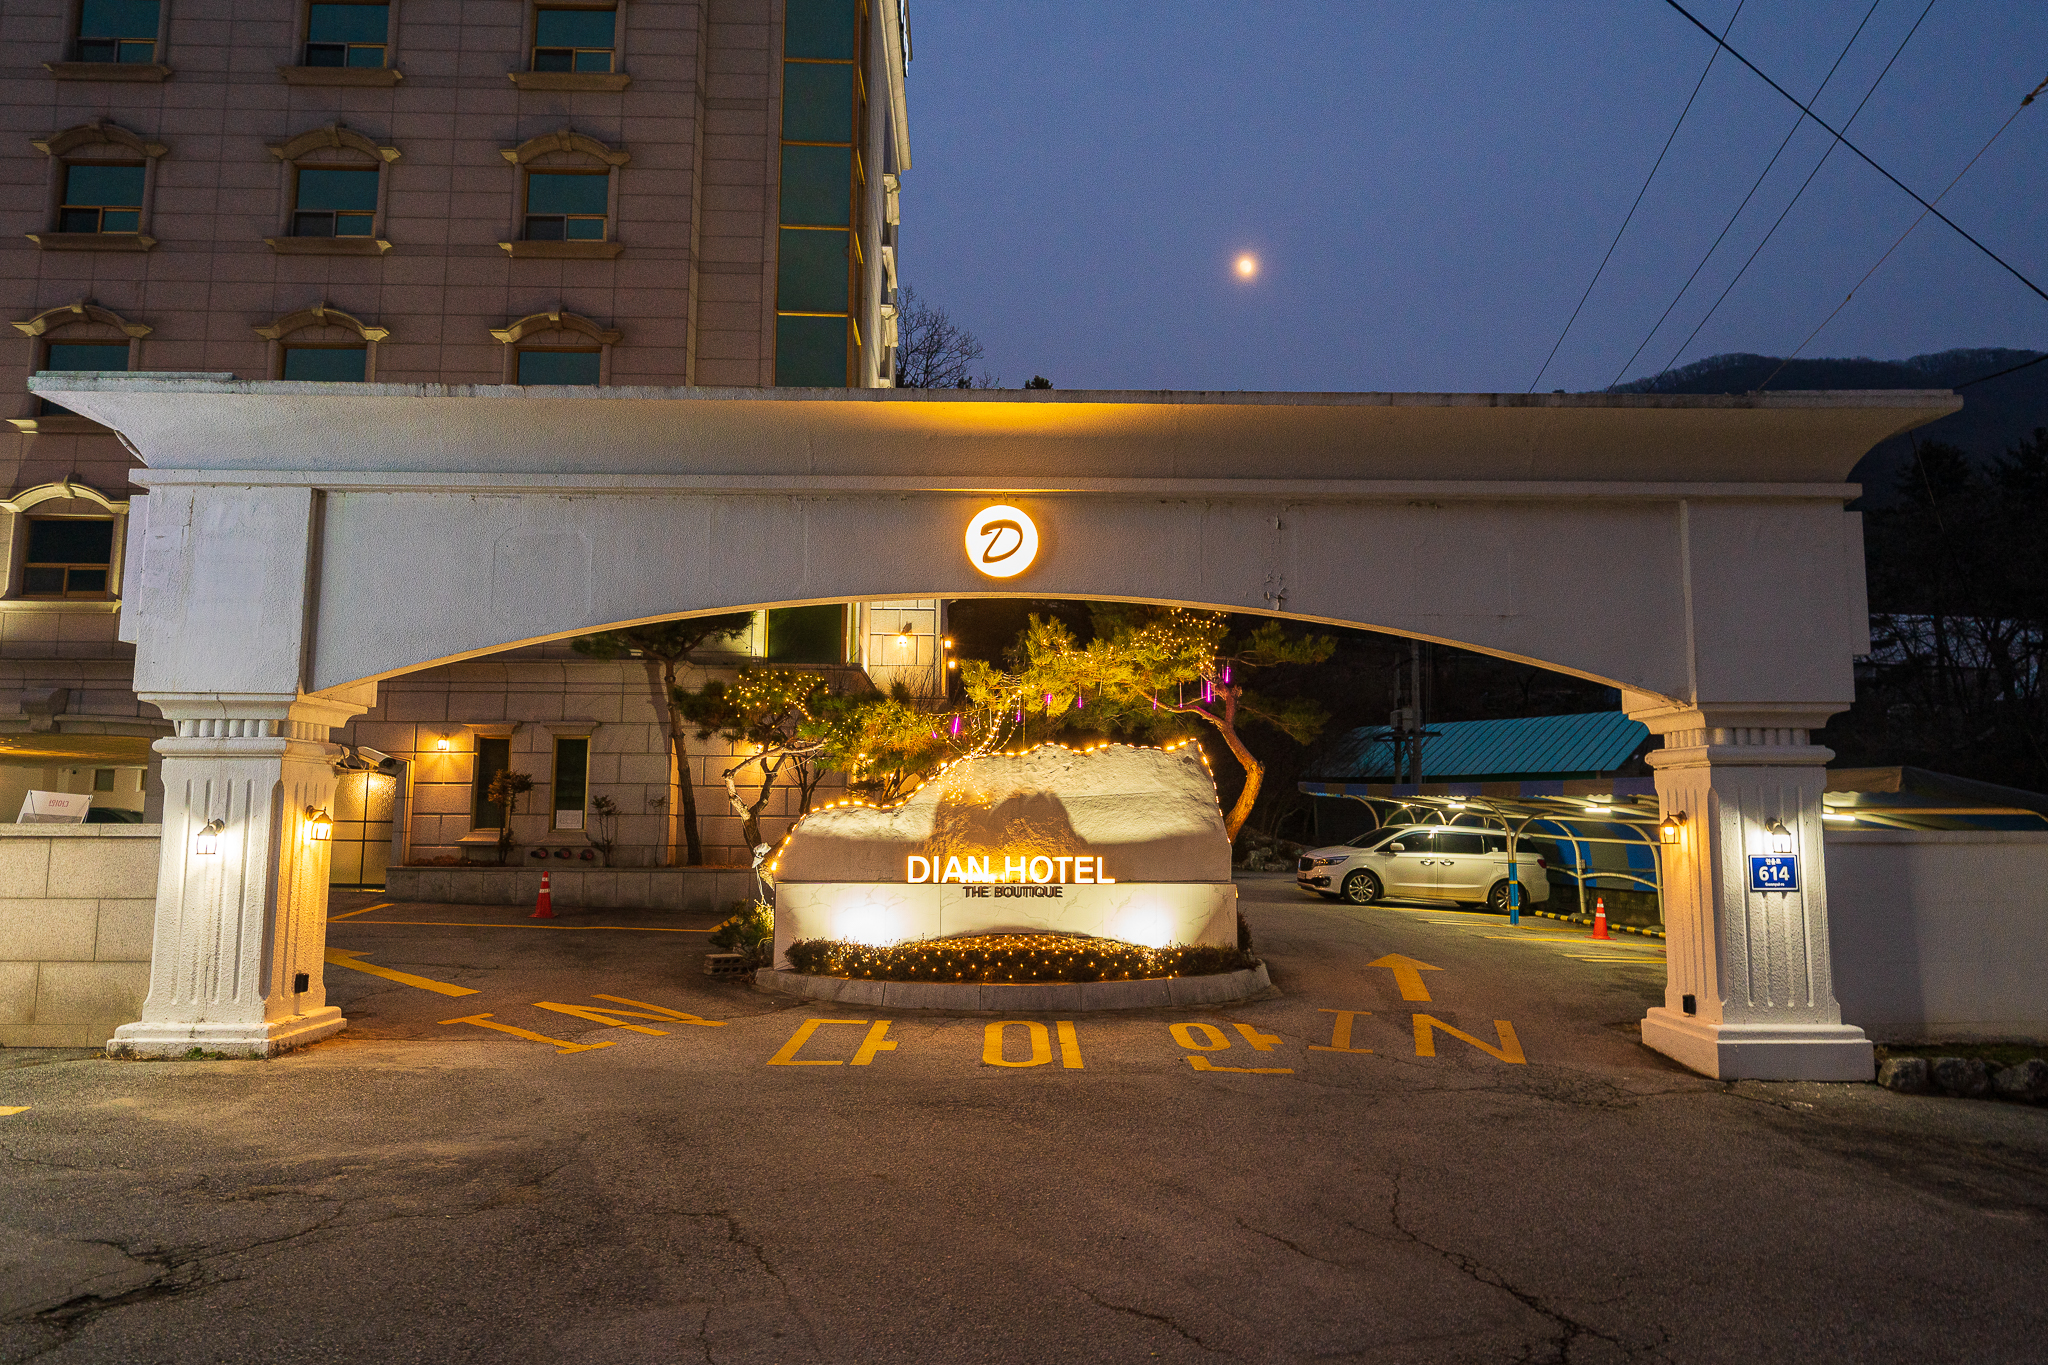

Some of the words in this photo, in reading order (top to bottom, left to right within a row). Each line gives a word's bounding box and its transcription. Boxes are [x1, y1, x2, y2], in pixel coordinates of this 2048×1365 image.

[906, 855, 990, 884] DIAN
[1003, 855, 1116, 884] HOTEL
[1758, 865, 1790, 882] 614
[962, 886, 991, 898] THE
[994, 886, 1064, 898] BOUTIQUE
[1307, 1007, 1528, 1065] IN
